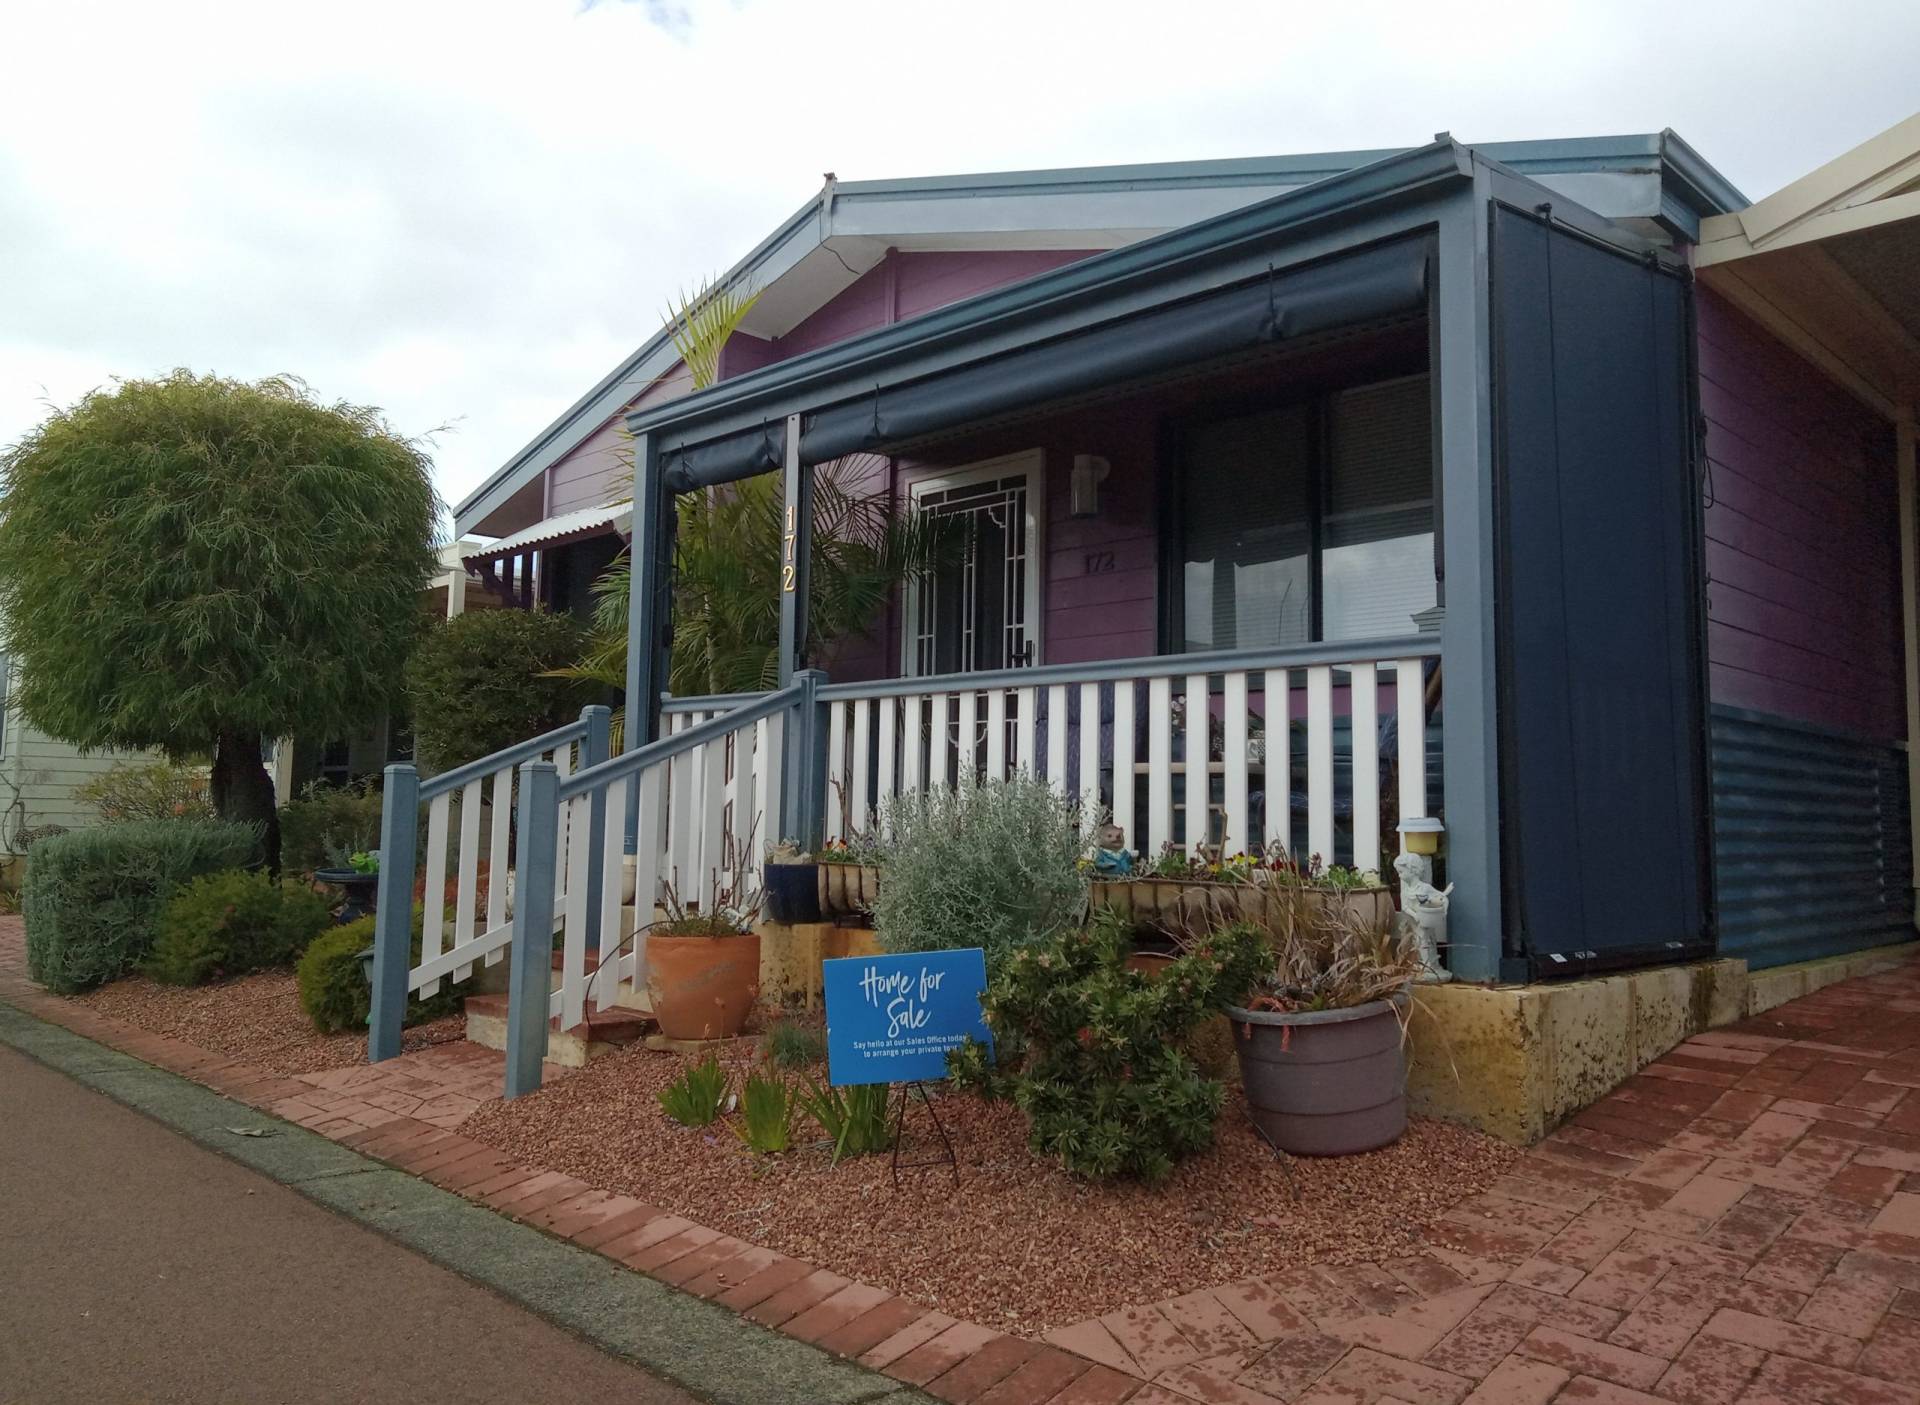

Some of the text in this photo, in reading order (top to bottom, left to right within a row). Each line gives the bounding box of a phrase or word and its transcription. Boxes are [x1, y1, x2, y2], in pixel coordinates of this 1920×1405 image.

[783, 506, 795, 592] 172
[859, 966, 945, 1007] Home for
[887, 998, 931, 1038] Sale
[853, 1041, 866, 1050] Say
[867, 1040, 884, 1048] hello
[906, 1037, 925, 1045] Sales
[926, 1035, 946, 1043] Office
[863, 1050, 871, 1058] to
[872, 1049, 899, 1057] arrange
[900, 1048, 916, 1056] your
[918, 1046, 942, 1055] private
